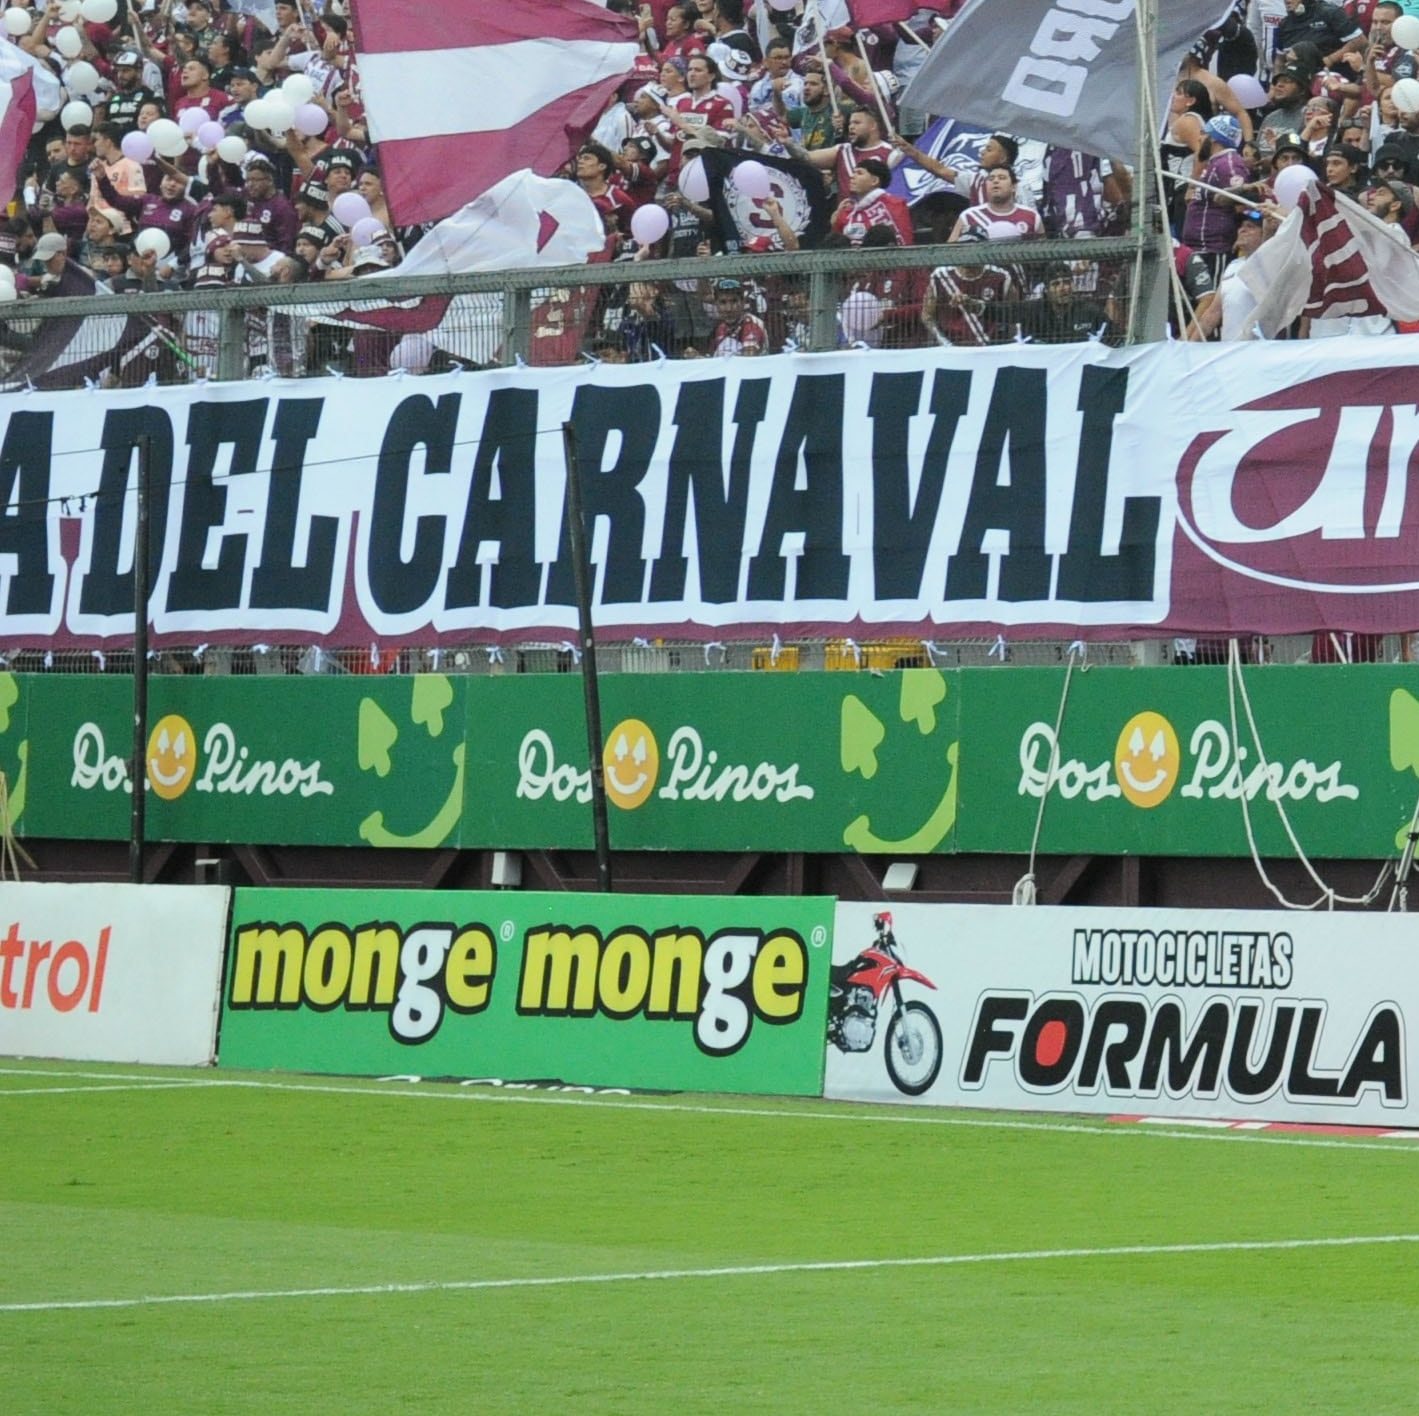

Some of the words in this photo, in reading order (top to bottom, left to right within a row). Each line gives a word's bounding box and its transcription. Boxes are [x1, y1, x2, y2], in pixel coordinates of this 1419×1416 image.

[80, 397, 342, 617] DEL
[367, 364, 1163, 616] CARNAVAL
[195, 721, 334, 797] Pinos
[658, 725, 813, 803] Pinos
[1018, 720, 1120, 801] Dos
[1181, 719, 1359, 802] Pinos
[230, 920, 499, 1045] monge
[517, 925, 809, 1056] monge
[1072, 928, 1294, 989] MOTOCICLETAS
[962, 996, 1405, 1101] FORMULA
